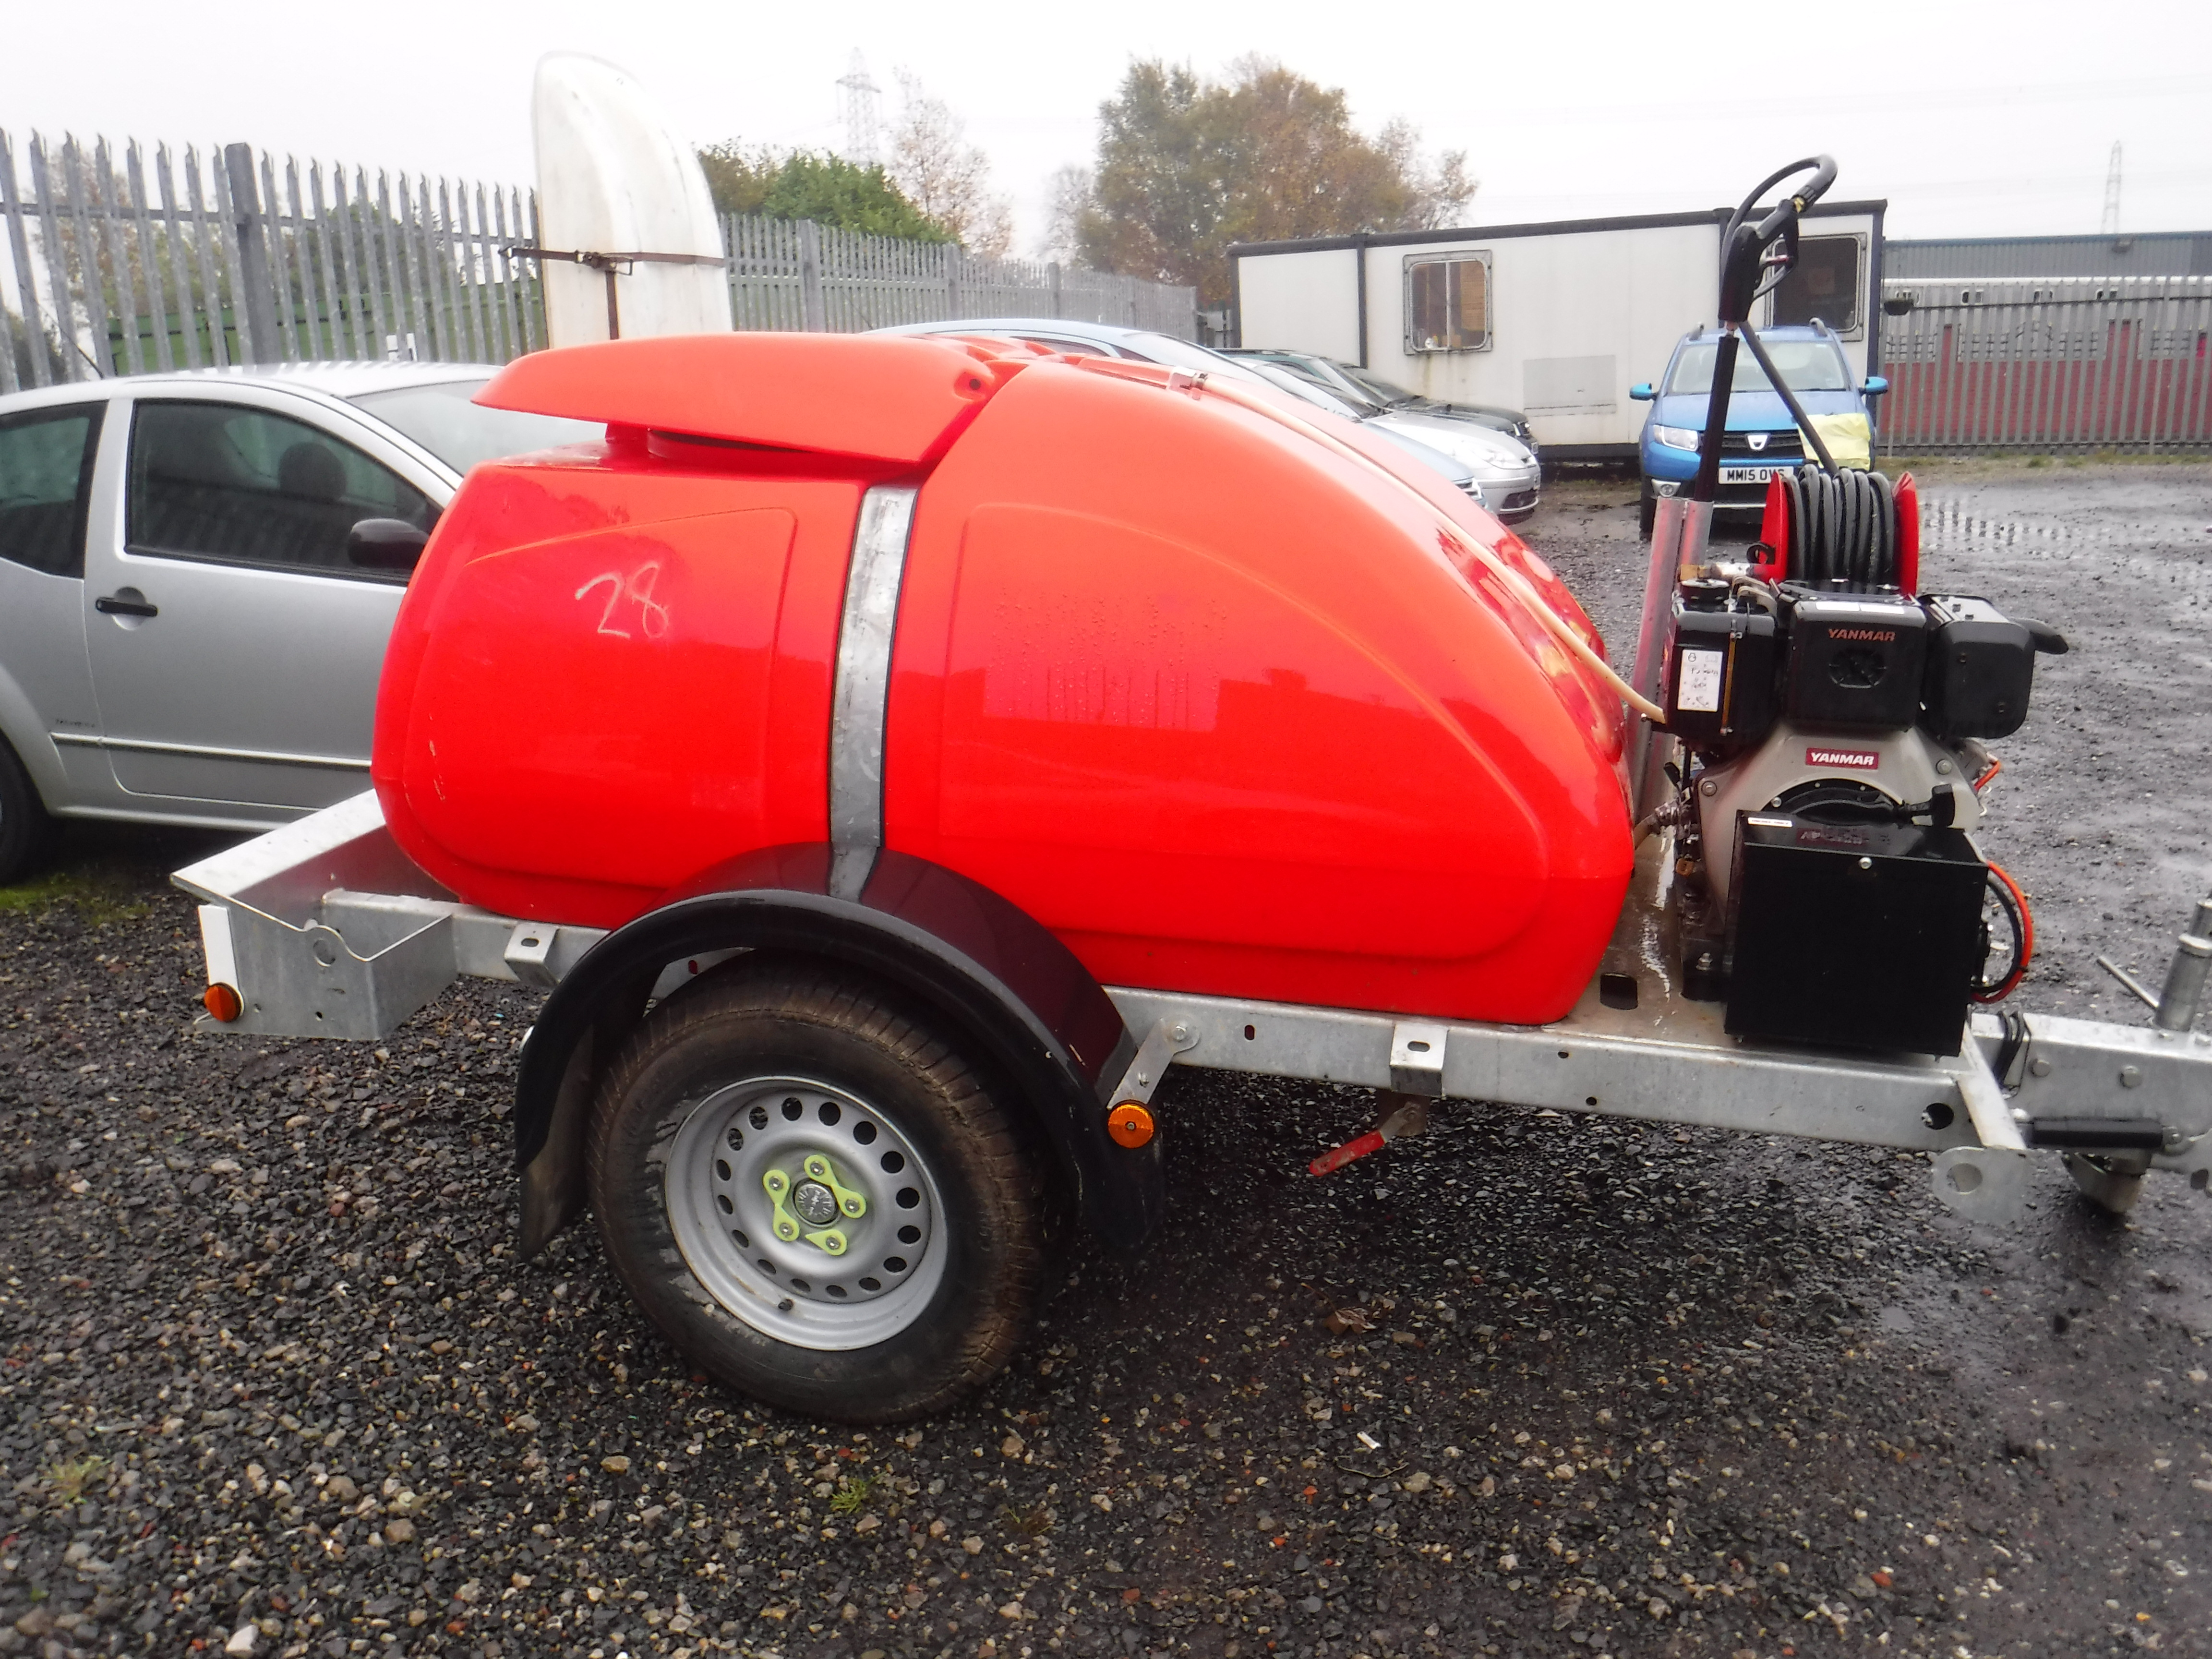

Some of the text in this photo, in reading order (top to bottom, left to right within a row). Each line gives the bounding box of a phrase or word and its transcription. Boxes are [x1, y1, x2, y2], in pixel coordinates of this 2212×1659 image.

[1727, 469, 1755, 481] MM15
[575, 560, 669, 639] 28
[1828, 628, 1896, 641] YANMAR
[1811, 752, 1875, 765] YANMAR
